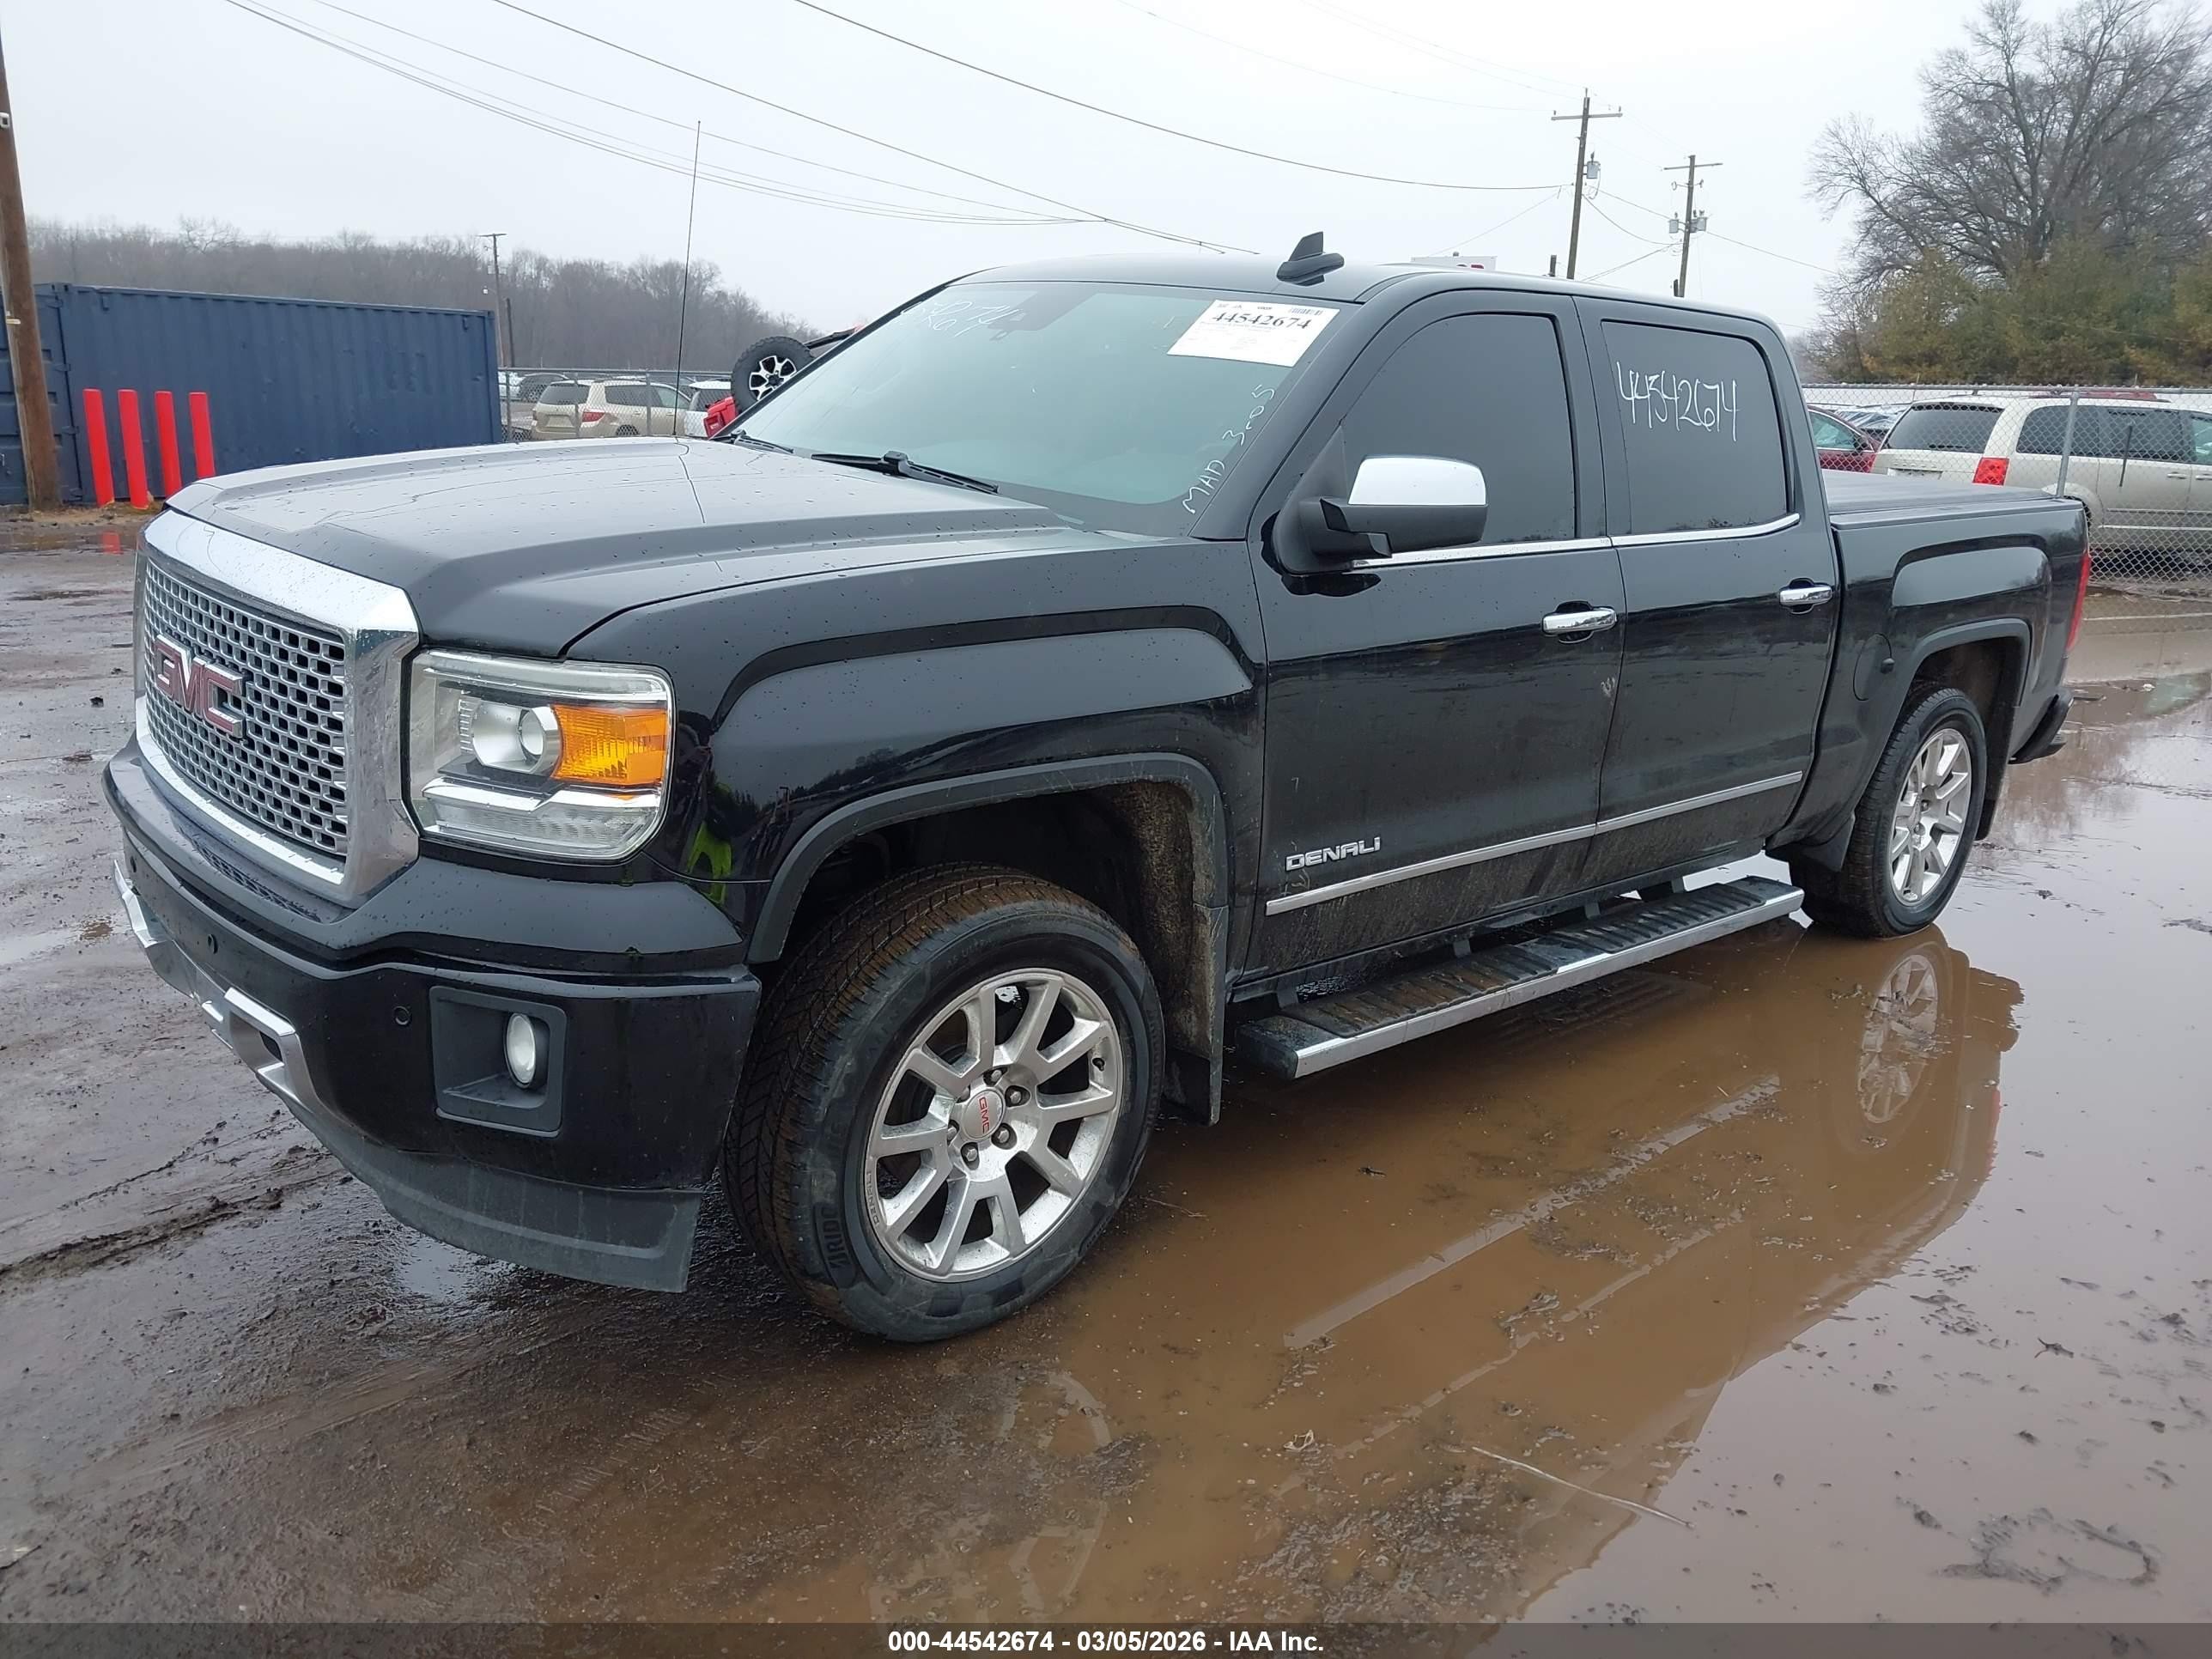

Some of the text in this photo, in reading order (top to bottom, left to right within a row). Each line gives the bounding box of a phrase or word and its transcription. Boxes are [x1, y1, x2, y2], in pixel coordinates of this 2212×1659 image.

[1212, 311, 1313, 330] 44542674
[1616, 361, 1740, 442] 44542674
[1182, 459, 1225, 514] MAD
[155, 634, 243, 738] GMC
[1285, 836, 1381, 872] DENALI
[979, 1096, 990, 1134] GMC
